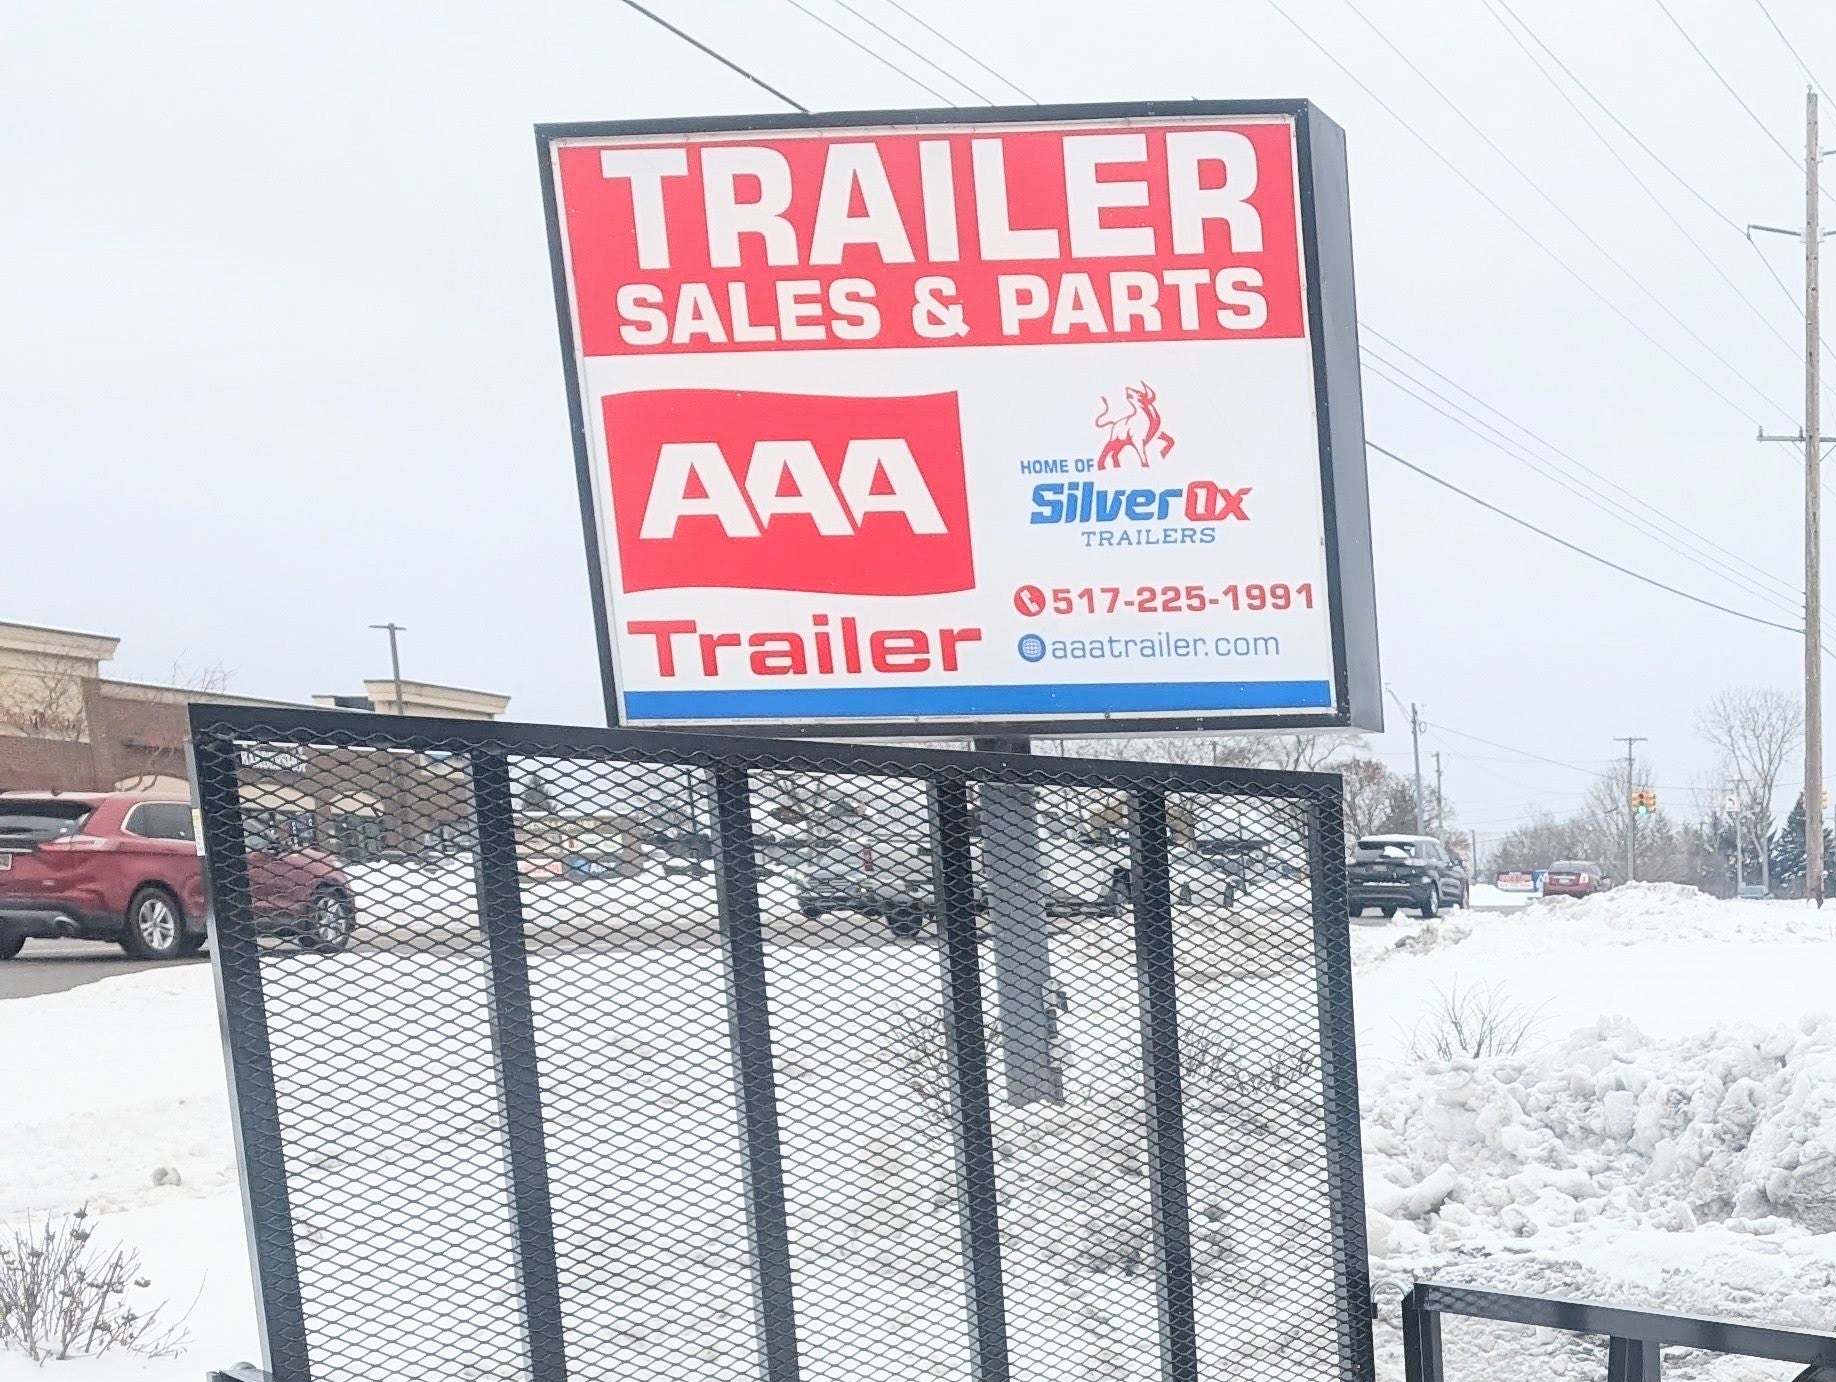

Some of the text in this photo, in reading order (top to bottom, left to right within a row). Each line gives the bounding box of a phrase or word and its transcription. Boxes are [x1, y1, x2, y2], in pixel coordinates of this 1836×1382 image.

[600, 131, 1264, 270] TRAILER
[616, 267, 1268, 346] SALES & PARTS
[639, 438, 949, 540] AAA
[1020, 458, 1094, 475] HOME OF
[1081, 527, 1216, 547] TRAILERS
[1052, 583, 1314, 615] 517-225-1991
[627, 613, 982, 677] Trailer
[1051, 632, 1280, 660] aaatrailer.com
